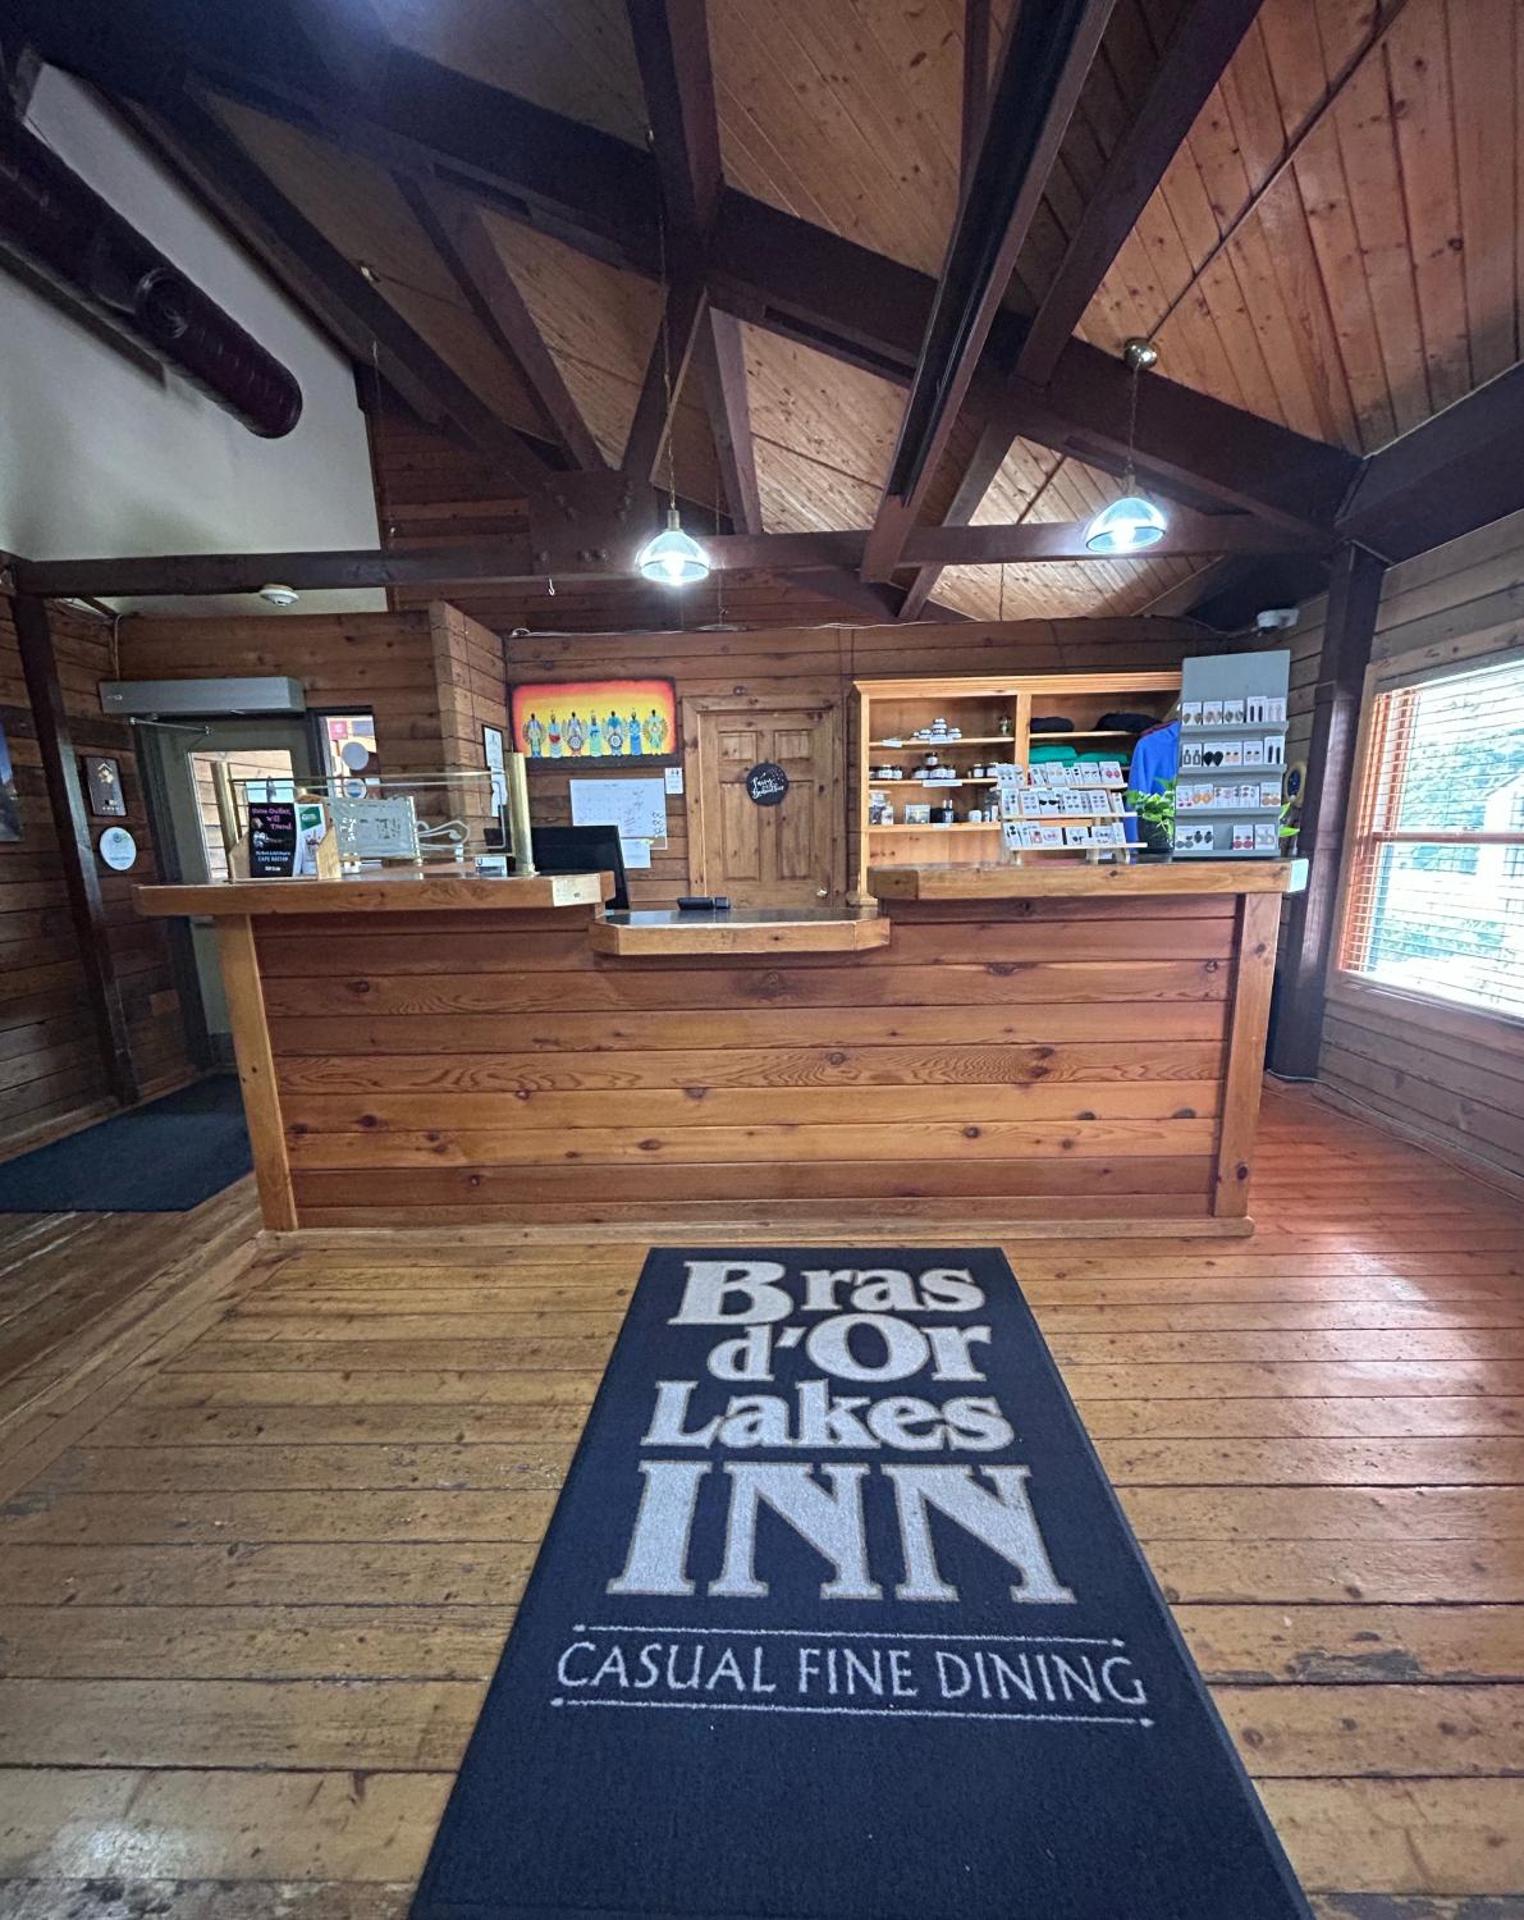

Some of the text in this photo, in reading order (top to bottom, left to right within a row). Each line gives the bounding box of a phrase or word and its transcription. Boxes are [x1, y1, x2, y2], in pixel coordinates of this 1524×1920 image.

[667, 1260, 985, 1325] Bras
[707, 1313, 992, 1382] d'Or
[640, 1378, 1015, 1450] Lakes
[605, 1460, 1078, 1604] INN
[557, 1641, 1147, 1704] CASUAL FINE DINING
